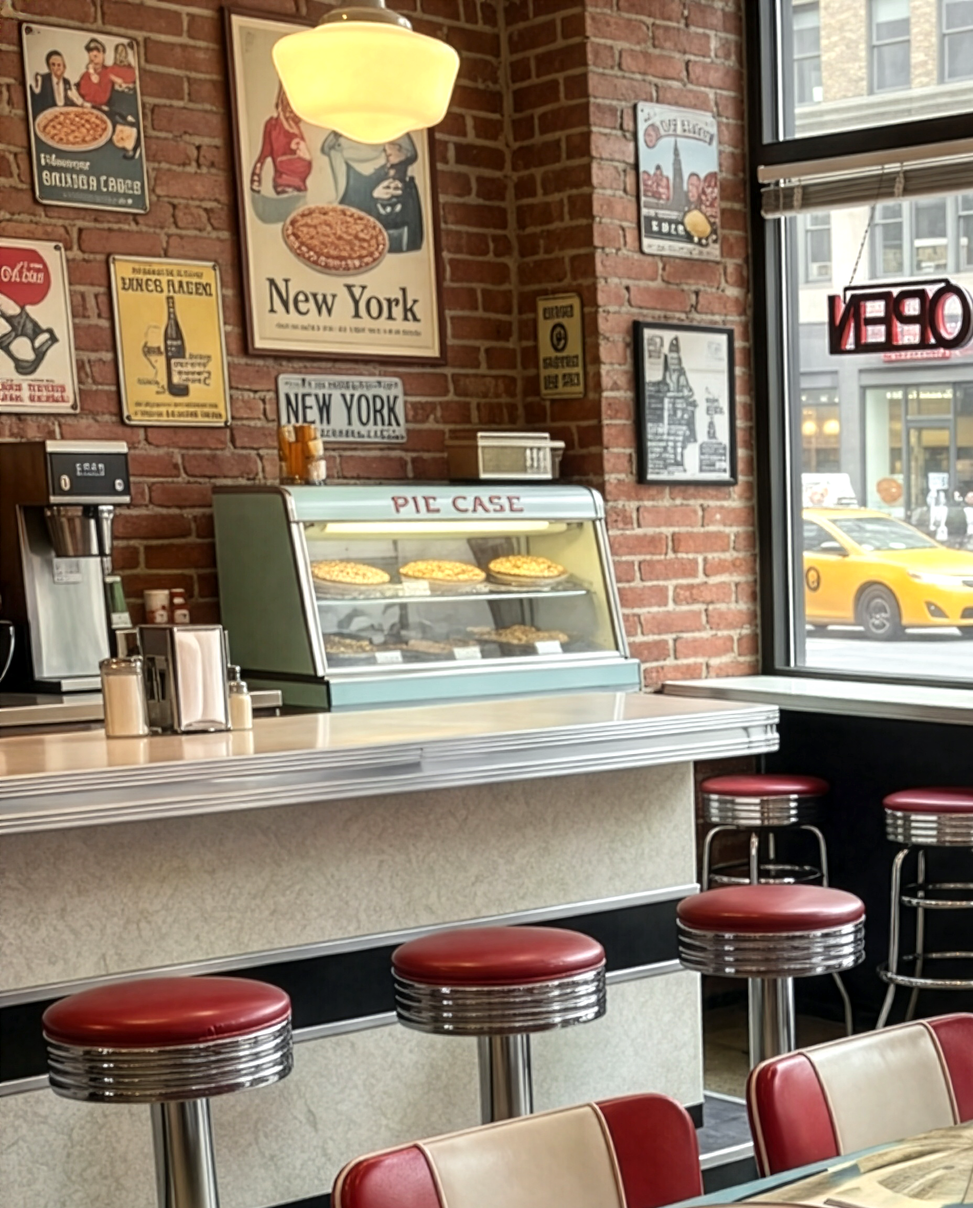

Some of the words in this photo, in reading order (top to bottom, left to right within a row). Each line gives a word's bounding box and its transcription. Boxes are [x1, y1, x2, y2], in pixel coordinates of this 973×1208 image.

[266, 277, 338, 318] New
[343, 283, 421, 323] York
[284, 392, 333, 426] NEW
[341, 393, 401, 427] YORK
[391, 495, 441, 514] PIE
[452, 495, 524, 513] CASE
